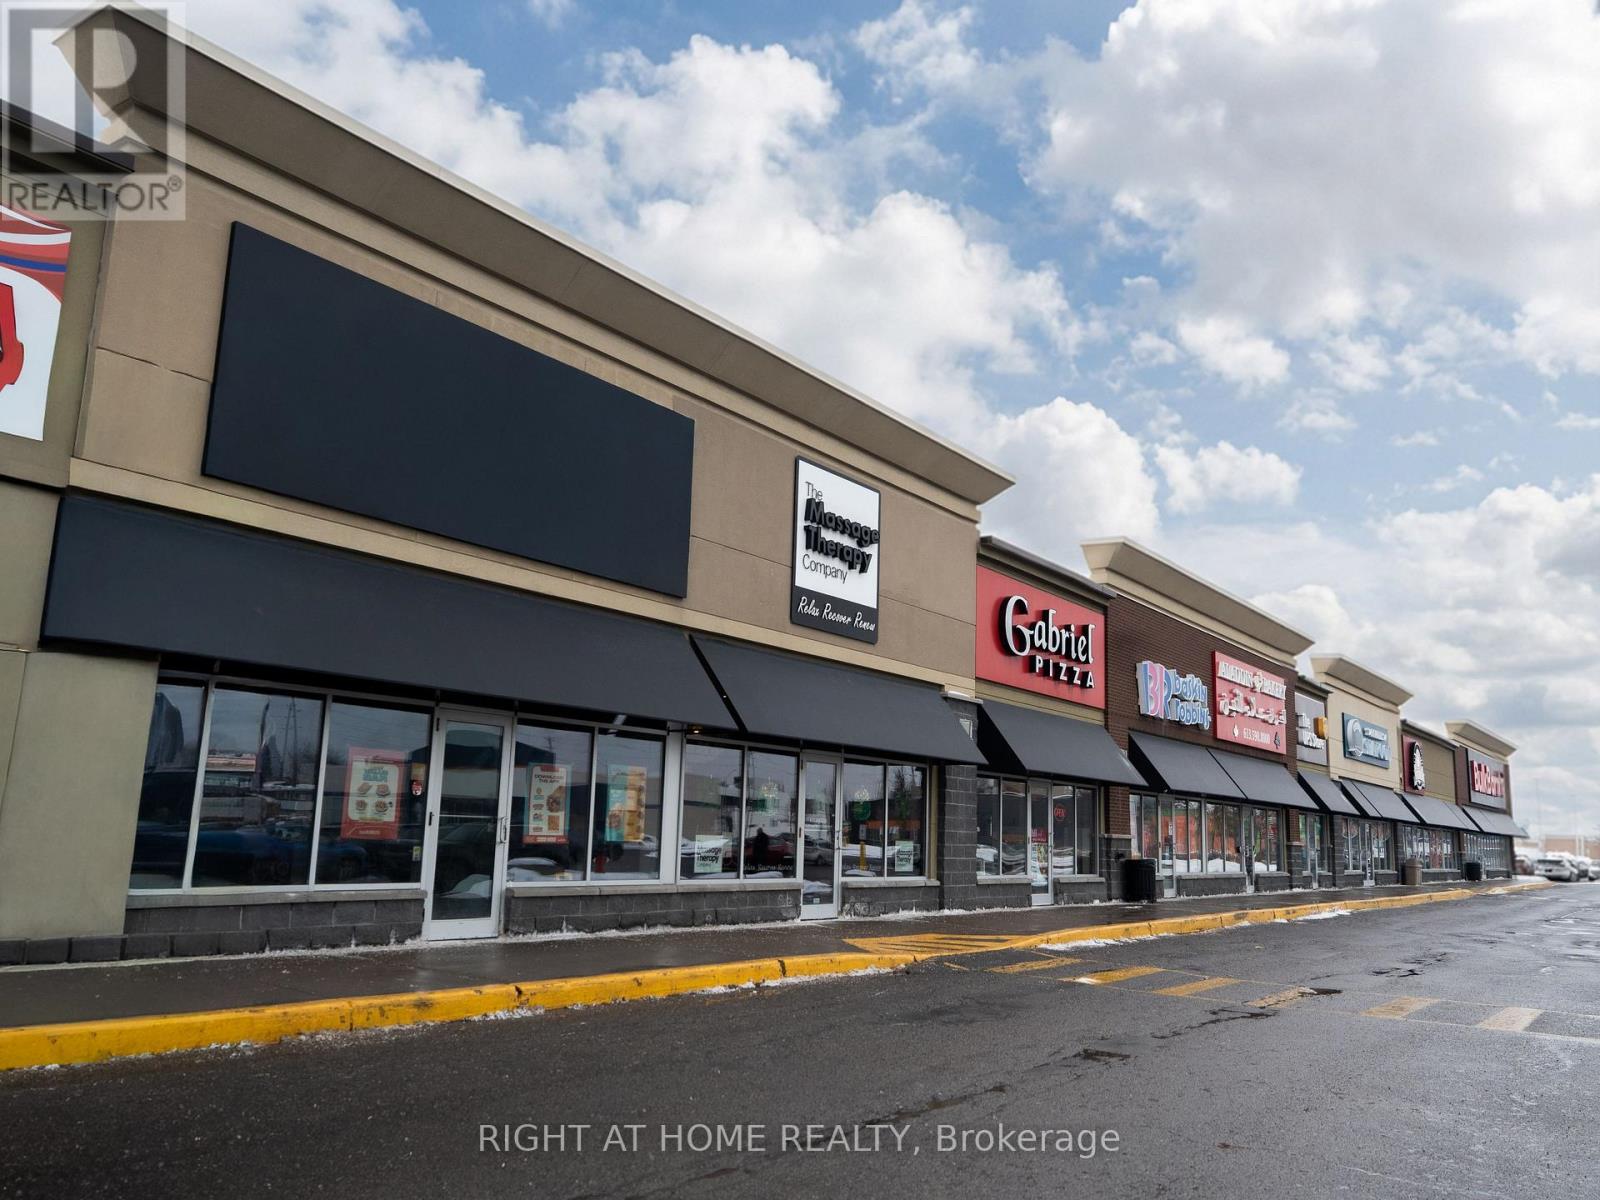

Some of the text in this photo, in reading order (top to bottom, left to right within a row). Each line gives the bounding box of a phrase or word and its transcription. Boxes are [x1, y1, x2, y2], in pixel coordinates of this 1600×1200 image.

[805, 481, 824, 502] The
[804, 498, 880, 547] Massage
[804, 525, 872, 574] Therapy
[802, 553, 848, 584] Company
[797, 596, 876, 631] Relax Recover Renew
[1003, 595, 1096, 664] Gabriel
[1035, 655, 1095, 688] PIZZA
